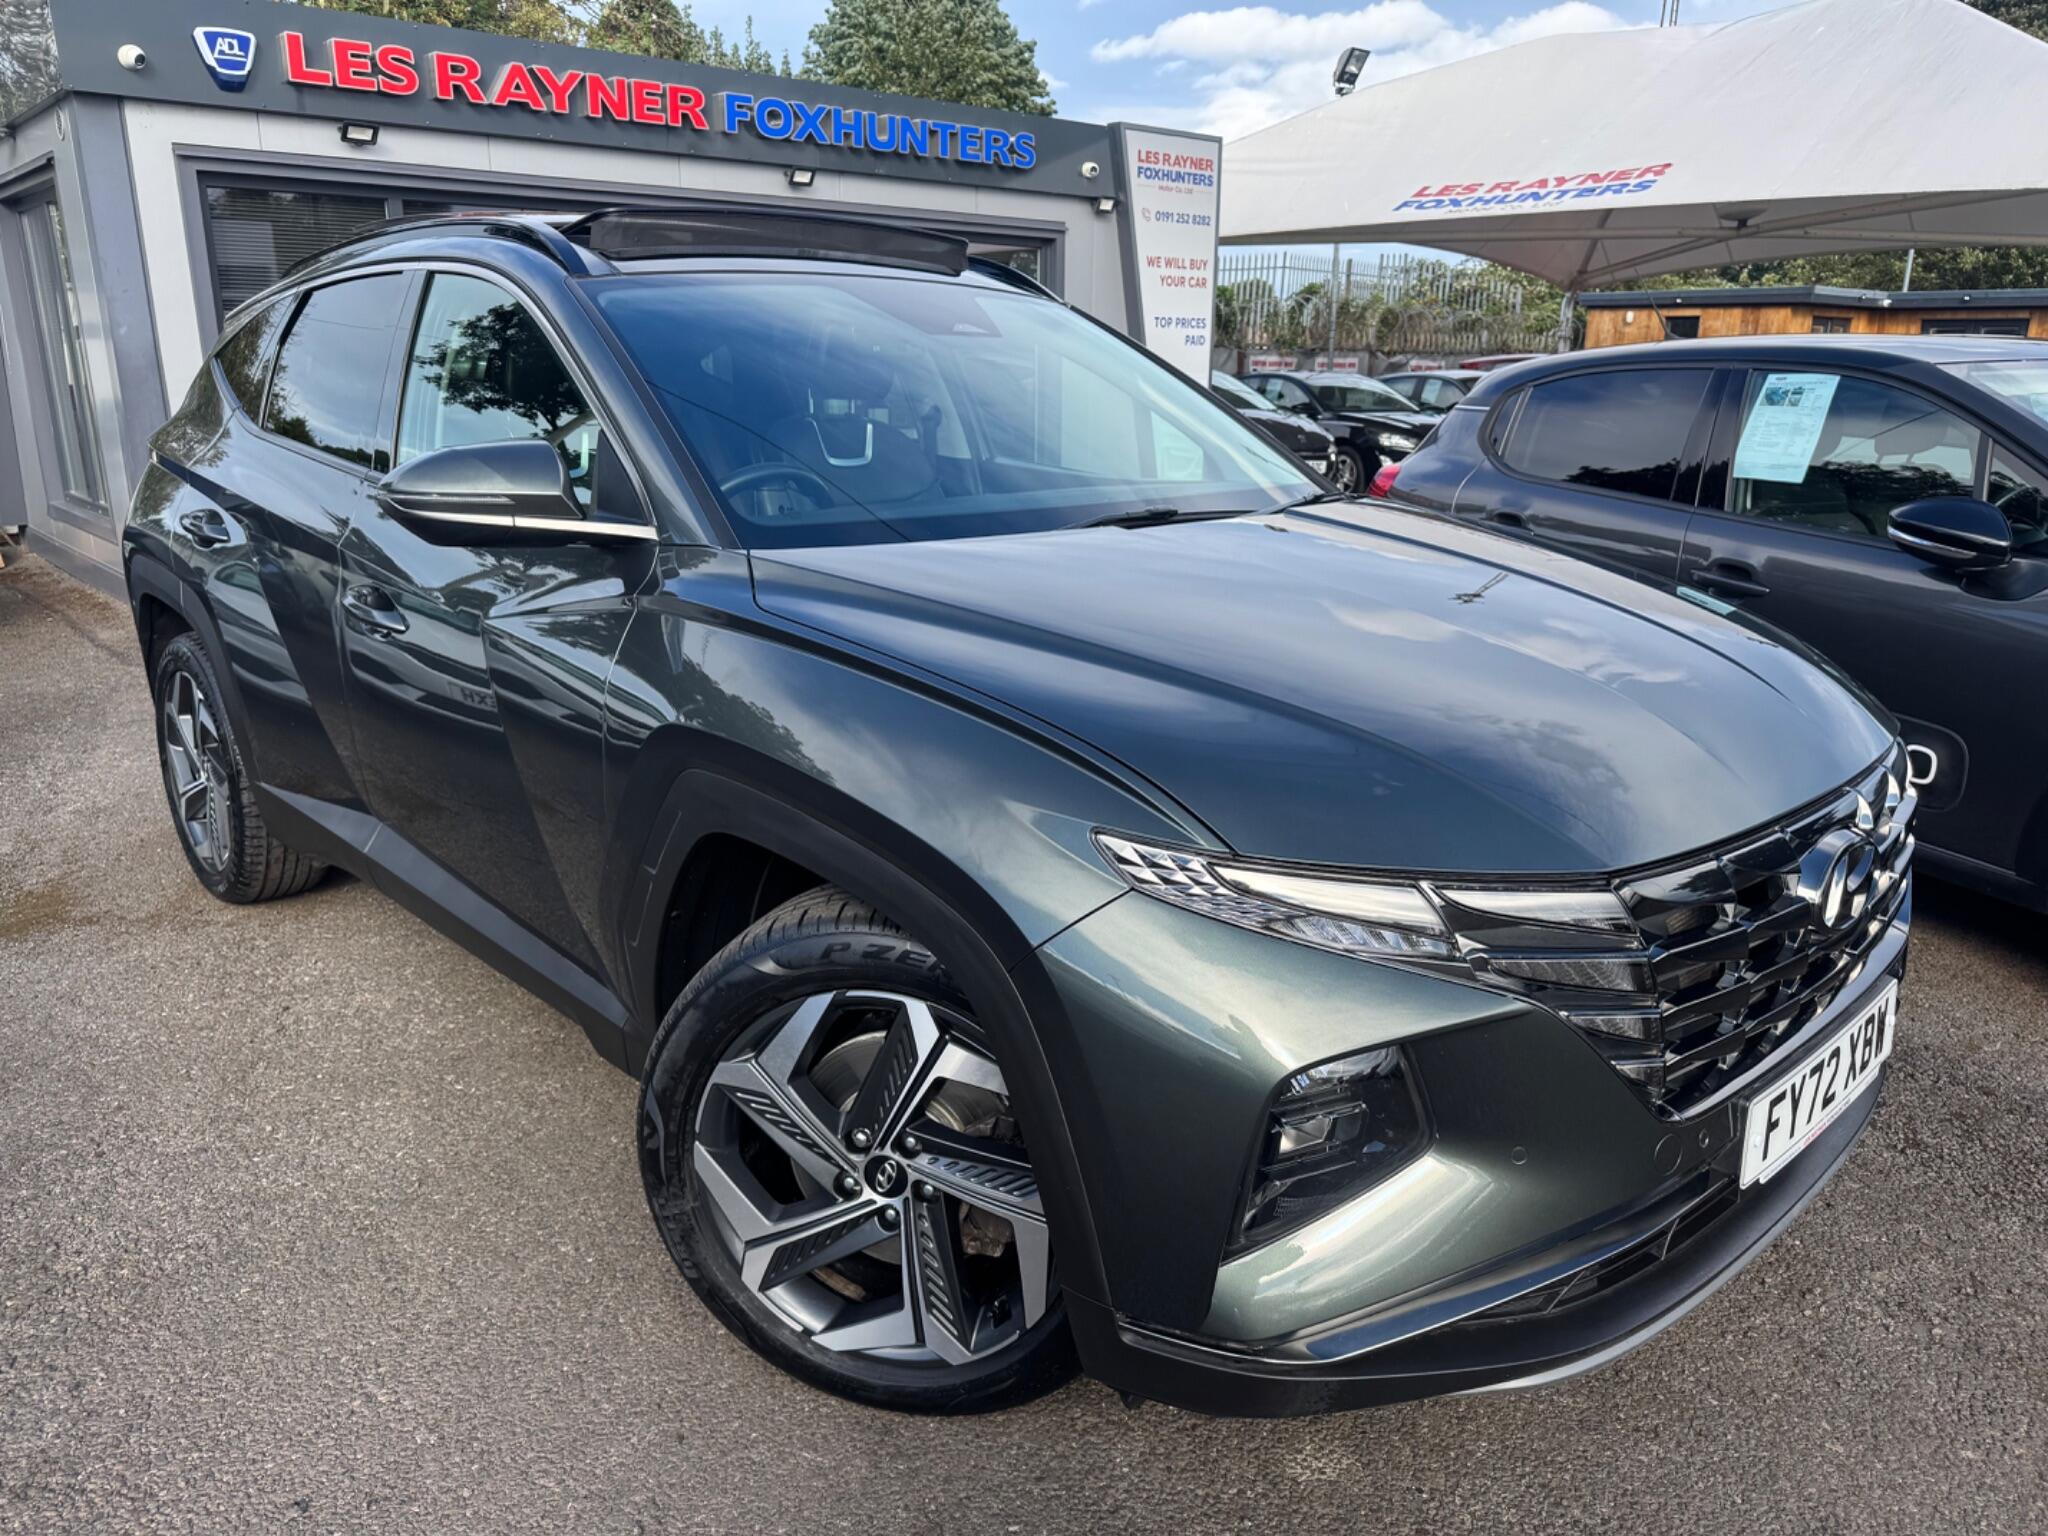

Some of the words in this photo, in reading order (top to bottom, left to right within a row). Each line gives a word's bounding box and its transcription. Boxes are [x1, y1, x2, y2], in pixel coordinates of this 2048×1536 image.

[213, 36, 246, 58] ADL
[280, 30, 420, 97] LES
[431, 50, 711, 131] RAYNER
[721, 91, 1037, 171] FOXHUNTERS
[1137, 149, 1160, 166] LES
[1162, 152, 1215, 173] RAYNER
[1136, 166, 1215, 187] FOXHUNTERS
[1410, 182, 1484, 199] LES
[1484, 162, 1674, 194] RAYNER
[1391, 179, 1659, 212] FOXHUNTERS
[1155, 210, 1174, 223] 0191
[1176, 212, 1191, 225] 252
[1192, 214, 1212, 227] 8282
[1146, 255, 1162, 268] WE
[1164, 256, 1187, 270] WILL
[1189, 258, 1209, 271] BUY
[1160, 274, 1186, 288] YOUR
[1188, 276, 1207, 289] CAR
[1154, 316, 1173, 329] TOP
[1175, 317, 1207, 330] PRICES
[1184, 334, 1206, 347] PAID
[818, 941, 852, 961] P
[1761, 1045, 1842, 1163] FY72
[1843, 996, 1891, 1092] XBW
